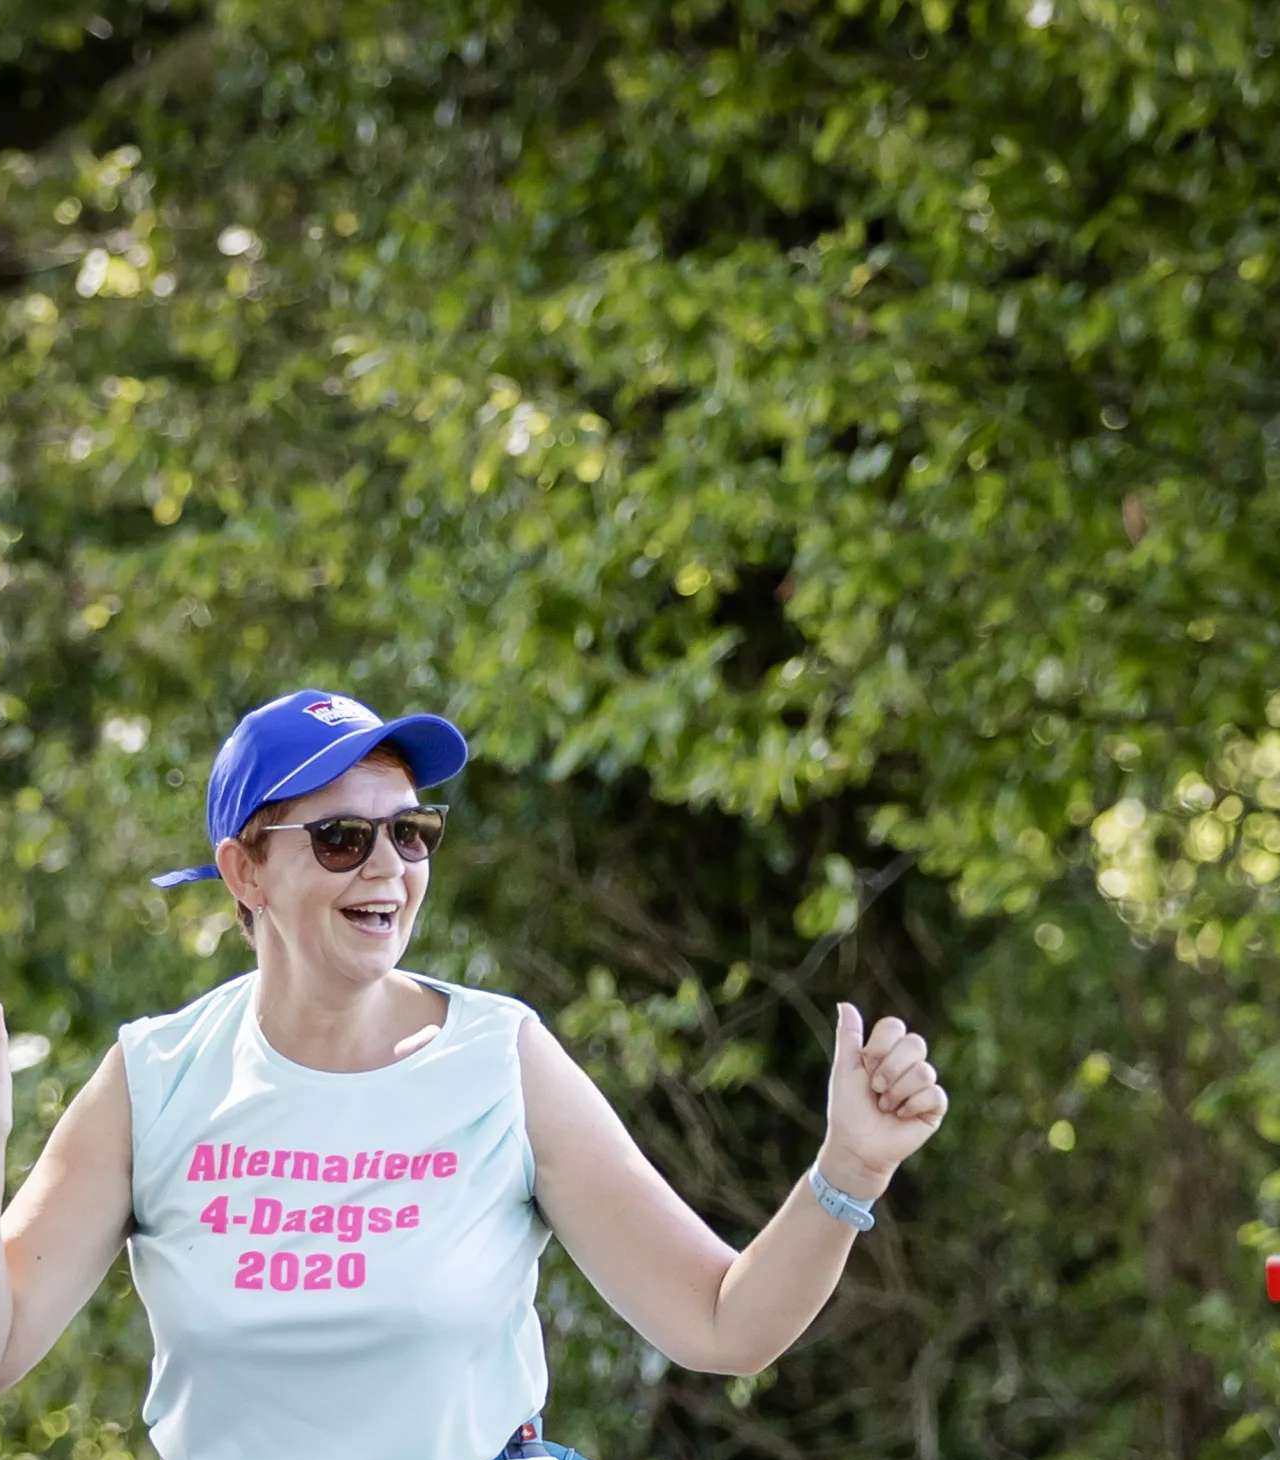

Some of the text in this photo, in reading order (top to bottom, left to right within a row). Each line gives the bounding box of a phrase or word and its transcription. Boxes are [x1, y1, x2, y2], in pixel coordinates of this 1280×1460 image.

[186, 1143, 458, 1183] Alternatieve
[200, 1195, 420, 1243] 4-Daagse
[234, 1250, 367, 1291] 2020
